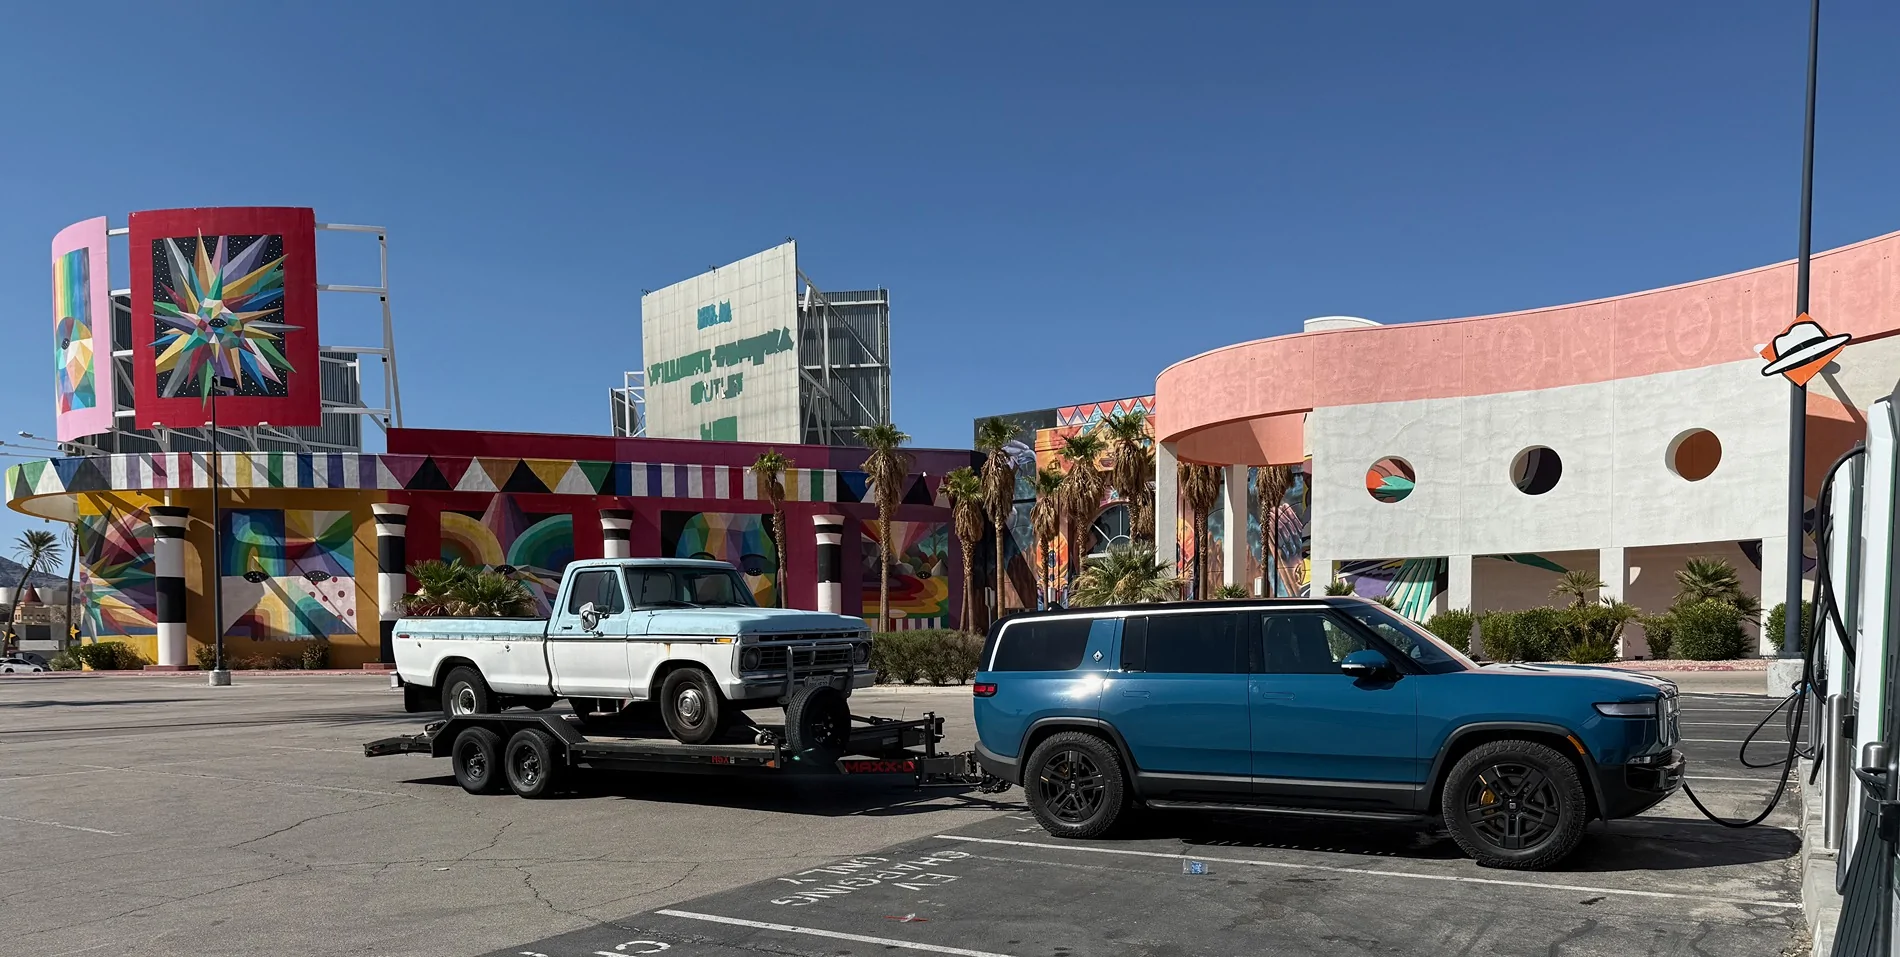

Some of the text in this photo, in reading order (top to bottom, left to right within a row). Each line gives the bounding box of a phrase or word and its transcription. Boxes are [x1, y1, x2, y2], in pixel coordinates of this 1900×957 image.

[846, 760, 915, 774] MAXX-D
[771, 850, 971, 906] CHARGING
[777, 856, 889, 885] ONLY
[892, 872, 962, 891] EV
